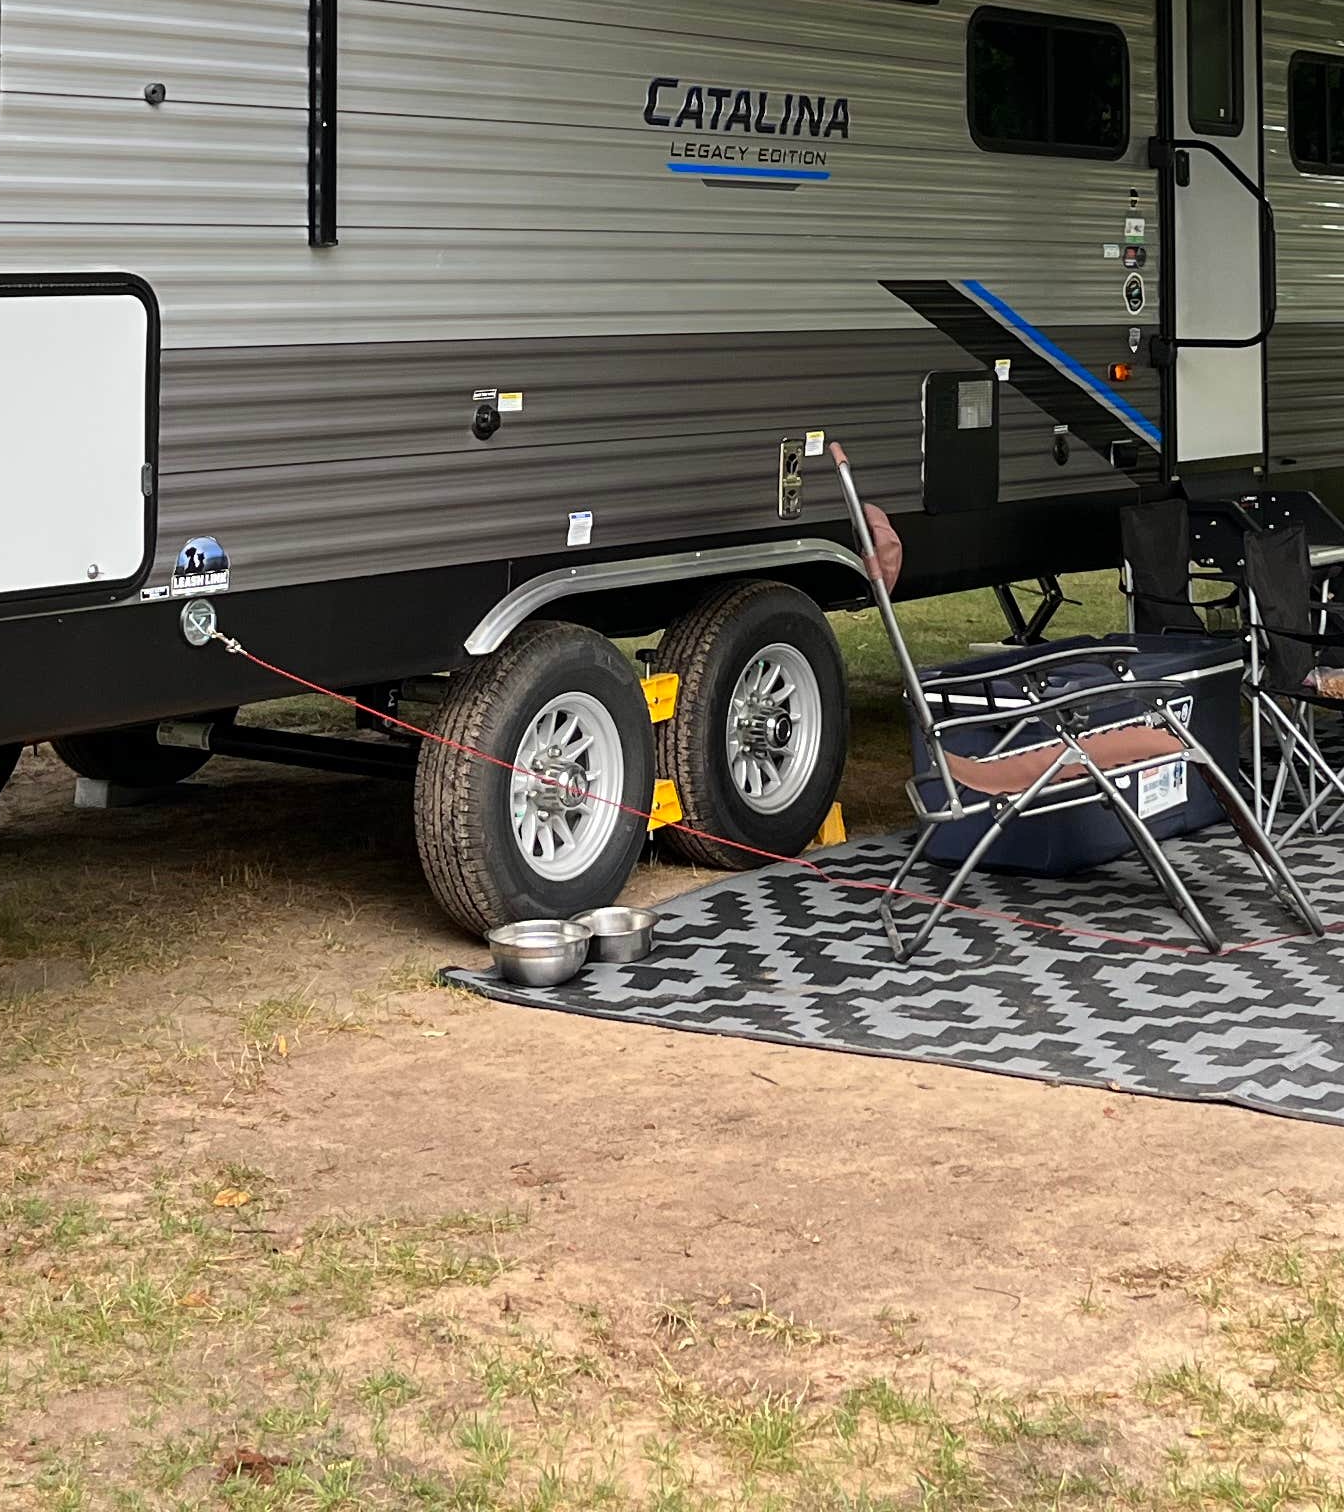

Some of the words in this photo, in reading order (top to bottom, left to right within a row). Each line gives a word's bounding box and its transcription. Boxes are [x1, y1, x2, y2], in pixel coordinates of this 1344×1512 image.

[643, 76, 851, 139] CATALINA
[670, 141, 749, 162] LEGACY
[758, 147, 827, 166] EDITION
